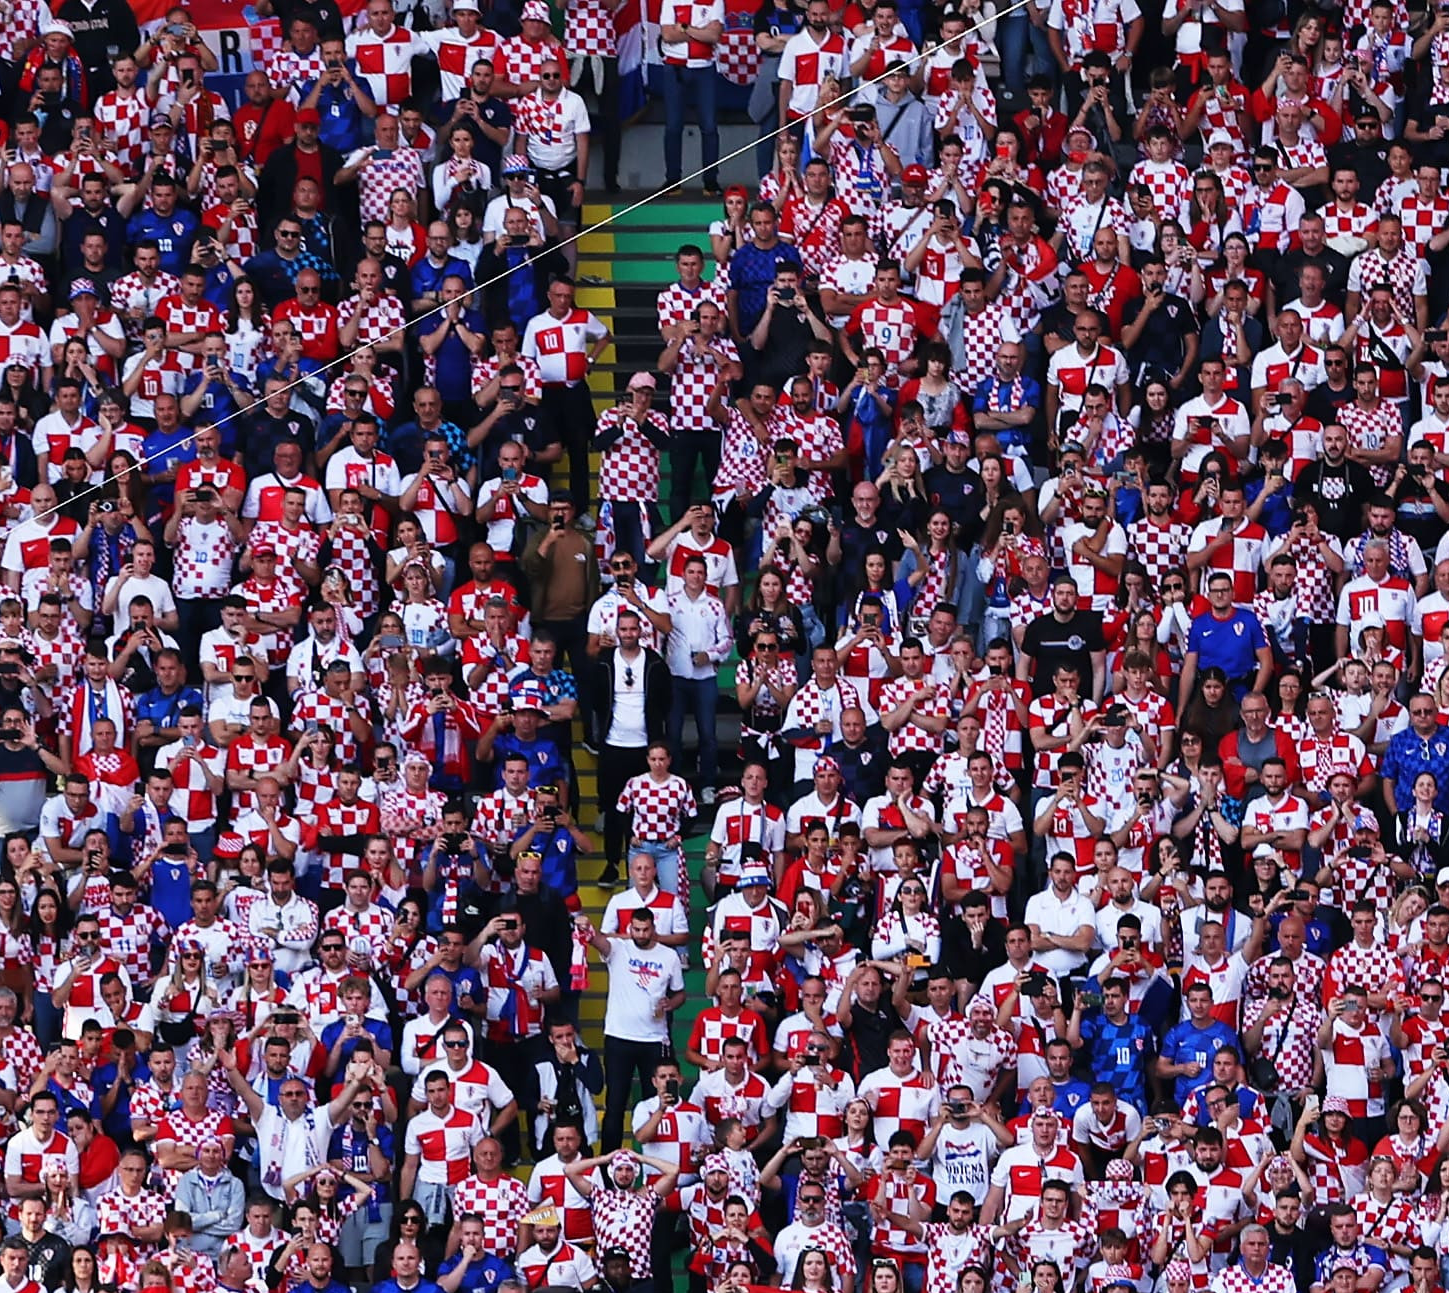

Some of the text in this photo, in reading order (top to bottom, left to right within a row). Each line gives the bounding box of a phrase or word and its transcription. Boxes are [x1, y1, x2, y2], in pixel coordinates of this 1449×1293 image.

[544, 333, 557, 348] 10
[881, 327, 892, 344] 9
[144, 380, 158, 396] 10
[1359, 599, 1372, 613] 10
[118, 940, 130, 951] 11
[1117, 1048, 1130, 1064] 10
[354, 1156, 366, 1172] 10
